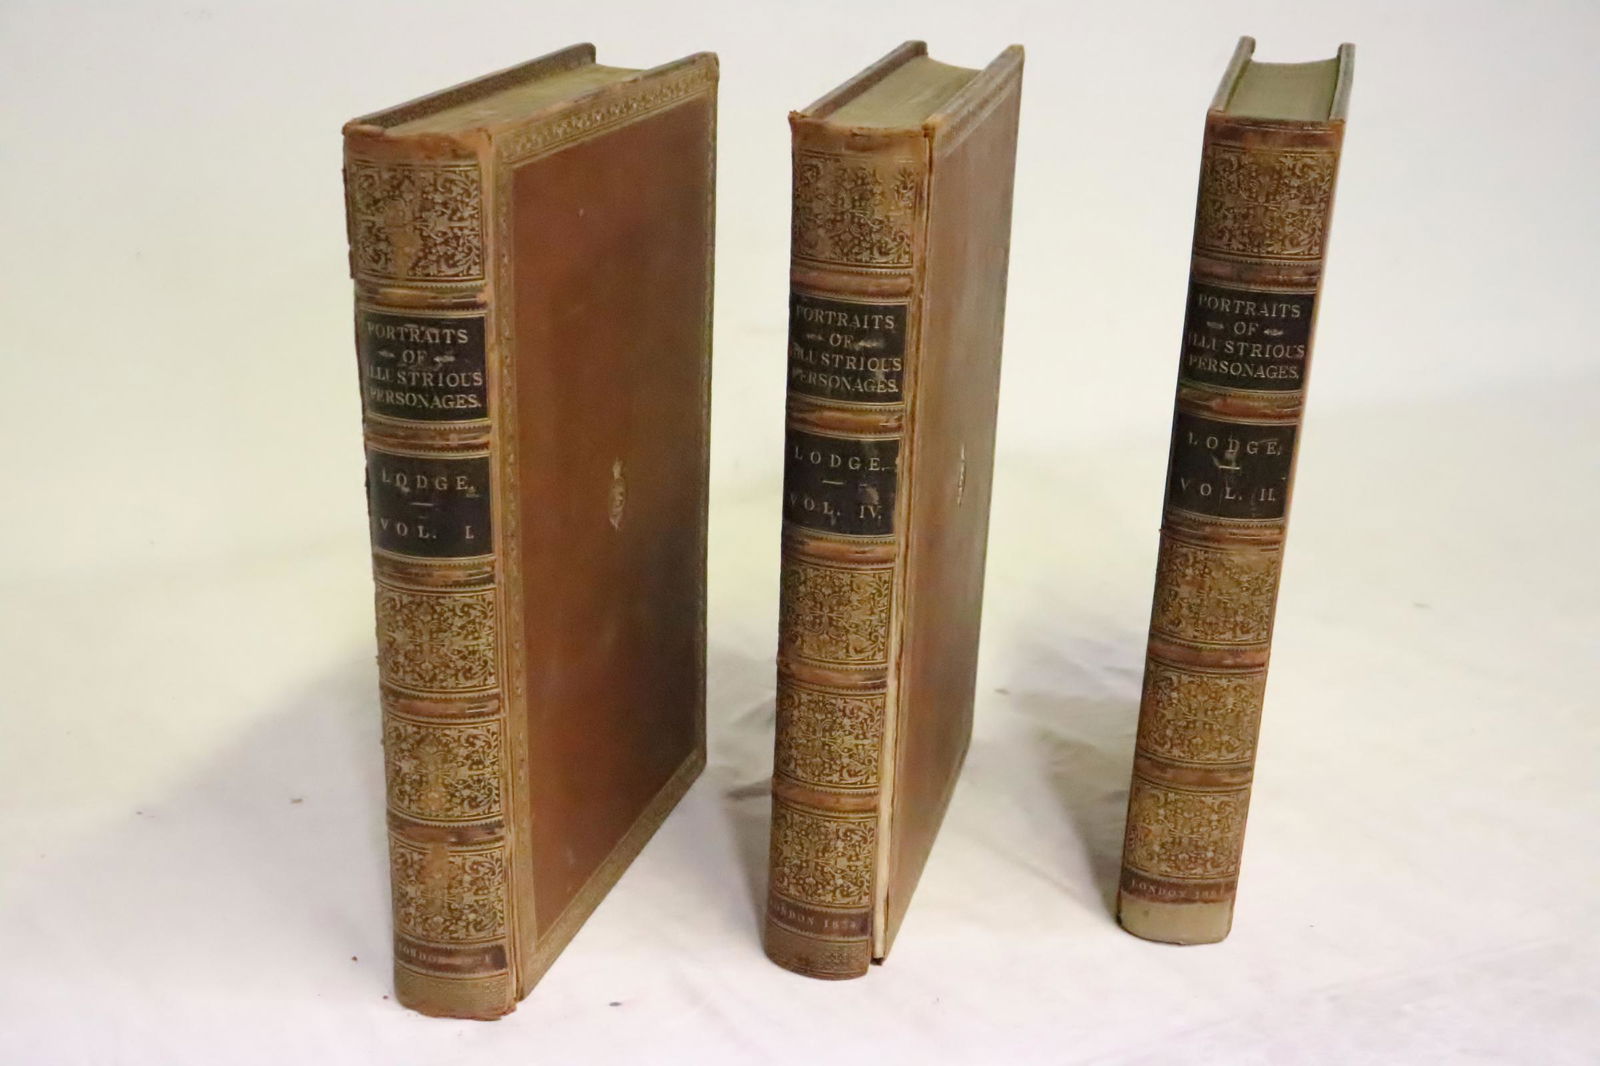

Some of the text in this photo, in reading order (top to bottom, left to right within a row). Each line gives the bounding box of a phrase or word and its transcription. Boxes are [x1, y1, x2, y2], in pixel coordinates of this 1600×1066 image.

[796, 304, 895, 329] PORTRAITS
[1199, 293, 1301, 318] PORTRAITS
[367, 321, 469, 344] PORTRAITS
[1233, 321, 1259, 336] OF
[829, 333, 854, 348] OF
[402, 348, 427, 363] OF
[1188, 432, 1281, 456] LODGE.
[795, 446, 885, 471] LODGE.
[1181, 478, 1242, 500] VOL.
[790, 492, 841, 516] VOL.
[380, 517, 437, 539] VOL.
